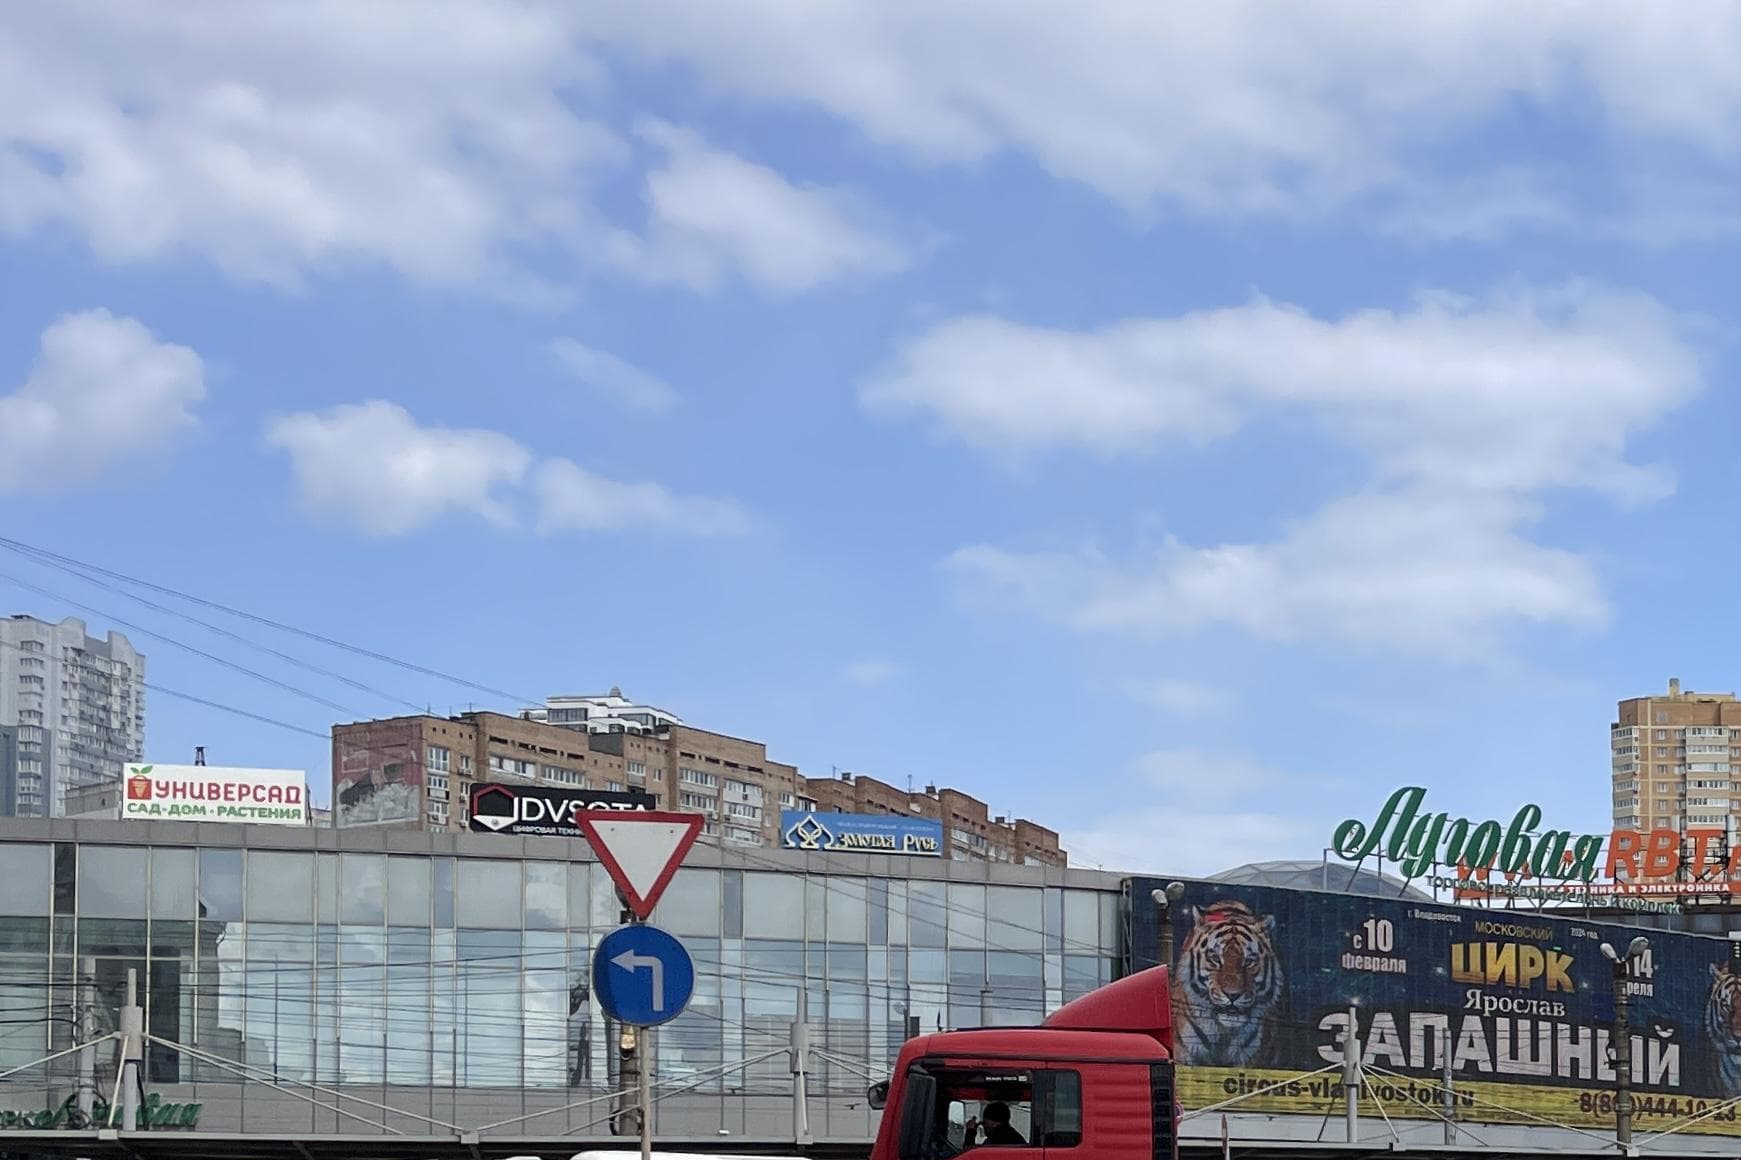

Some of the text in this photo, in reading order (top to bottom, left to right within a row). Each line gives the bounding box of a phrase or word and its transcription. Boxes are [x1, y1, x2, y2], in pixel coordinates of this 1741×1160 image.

[155, 780, 302, 804] УНИВЕРСАД
[217, 804, 302, 820] РАСТЕНИЯ
[1332, 786, 1604, 882] Луговая
[1640, 883, 1730, 894] ЭЛЕКТРОНИКА
[1364, 919, 1394, 953] 10
[1475, 920, 1553, 940] МОСКОВСКИЙ
[1341, 952, 1407, 975] февраля
[1451, 941, 1576, 993] ЦИРК
[1463, 988, 1567, 1018] Ярослав
